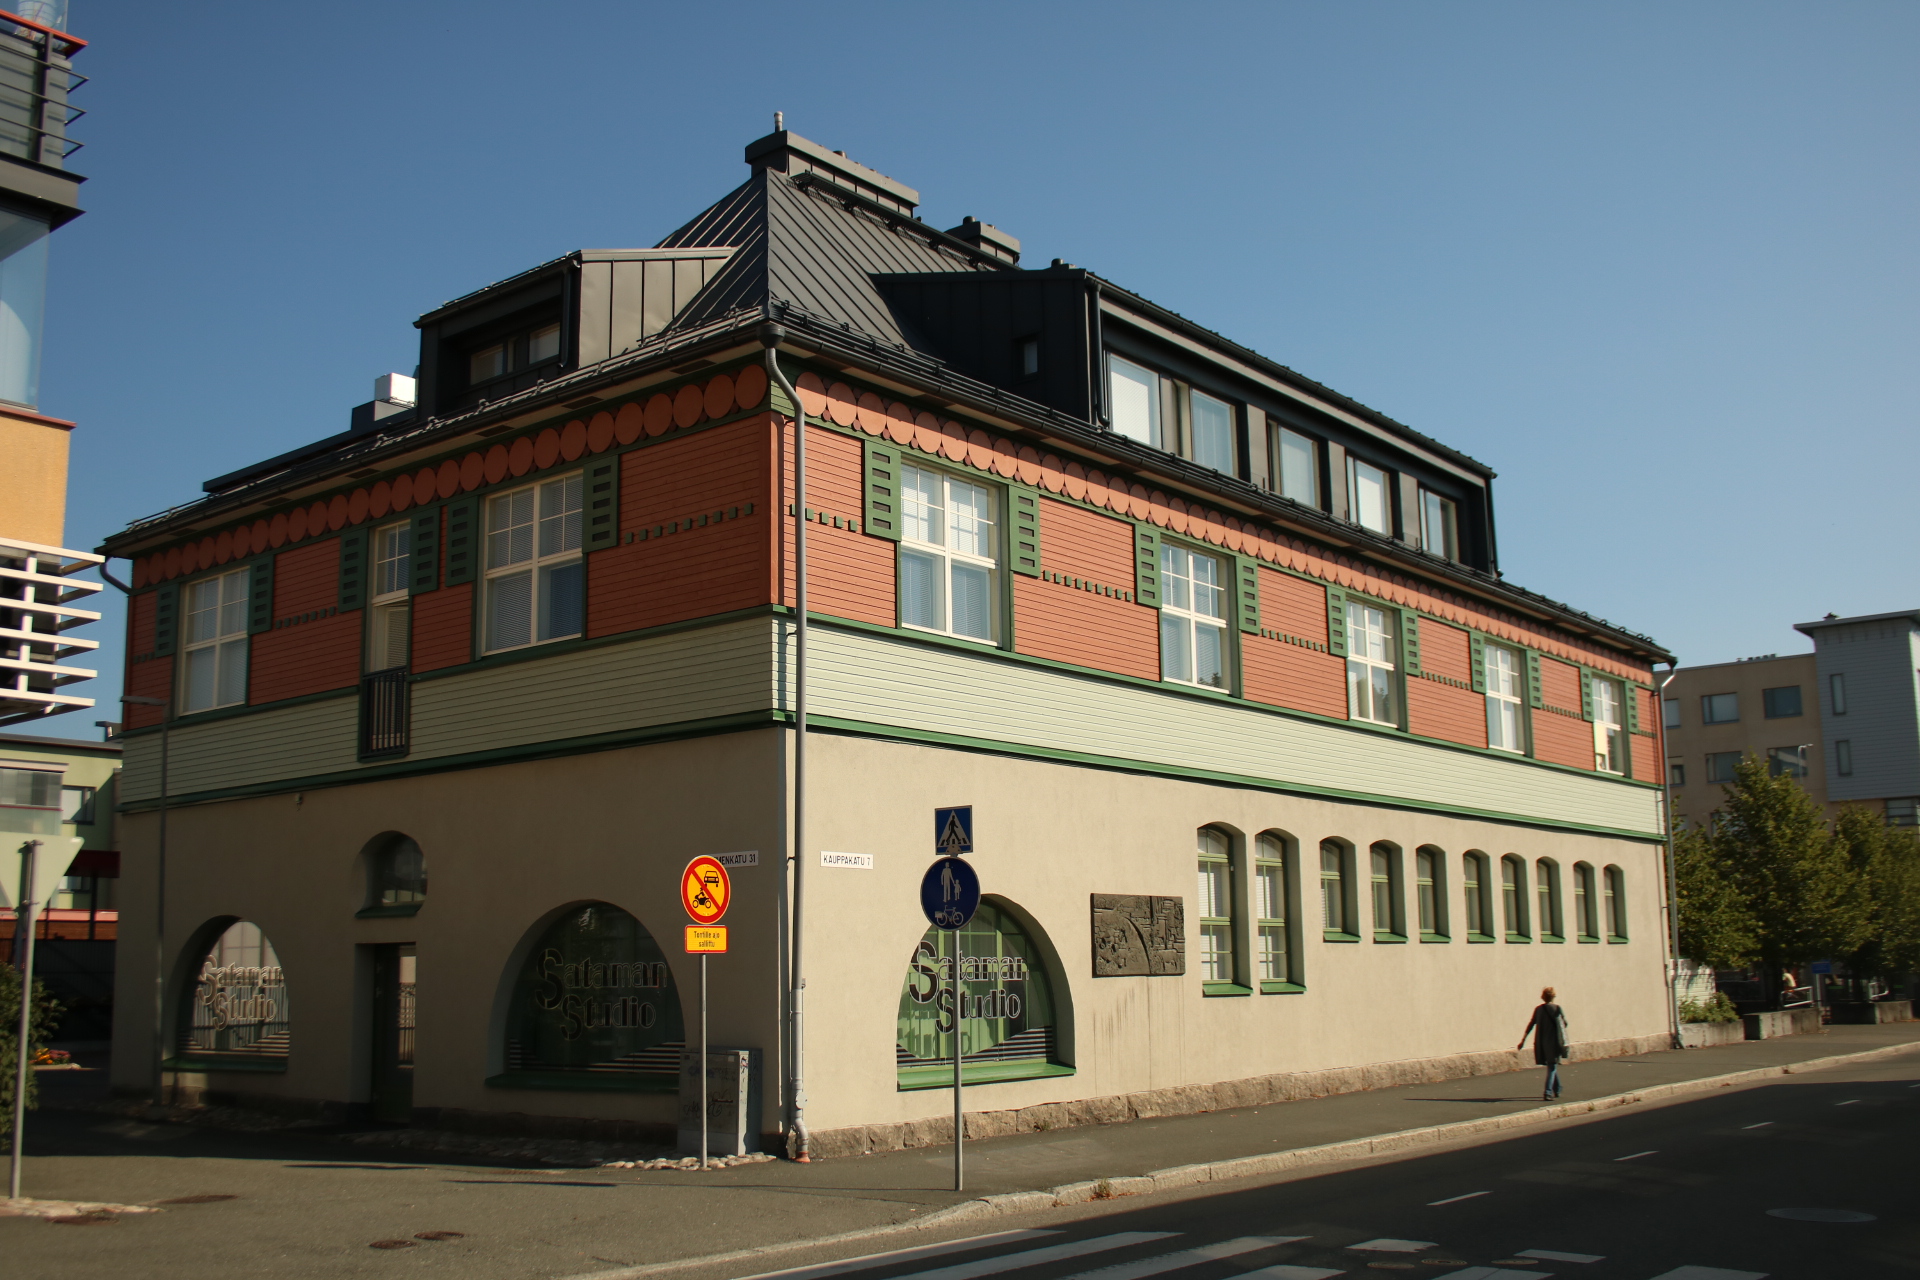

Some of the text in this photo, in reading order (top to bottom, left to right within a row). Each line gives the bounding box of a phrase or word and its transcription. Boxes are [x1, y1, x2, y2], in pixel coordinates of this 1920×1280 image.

[749, 853, 756, 863] 31
[823, 854, 871, 866] KAUPPAKATU 7
[698, 940, 715, 948] sallittu
[712, 931, 720, 939] ajo
[197, 954, 285, 1006] Sataman
[535, 948, 668, 1010] Sataman
[909, 940, 1030, 1004] Sataman
[212, 992, 277, 1031] Studio
[561, 994, 657, 1041] Studio
[935, 987, 1022, 1035] Studio
